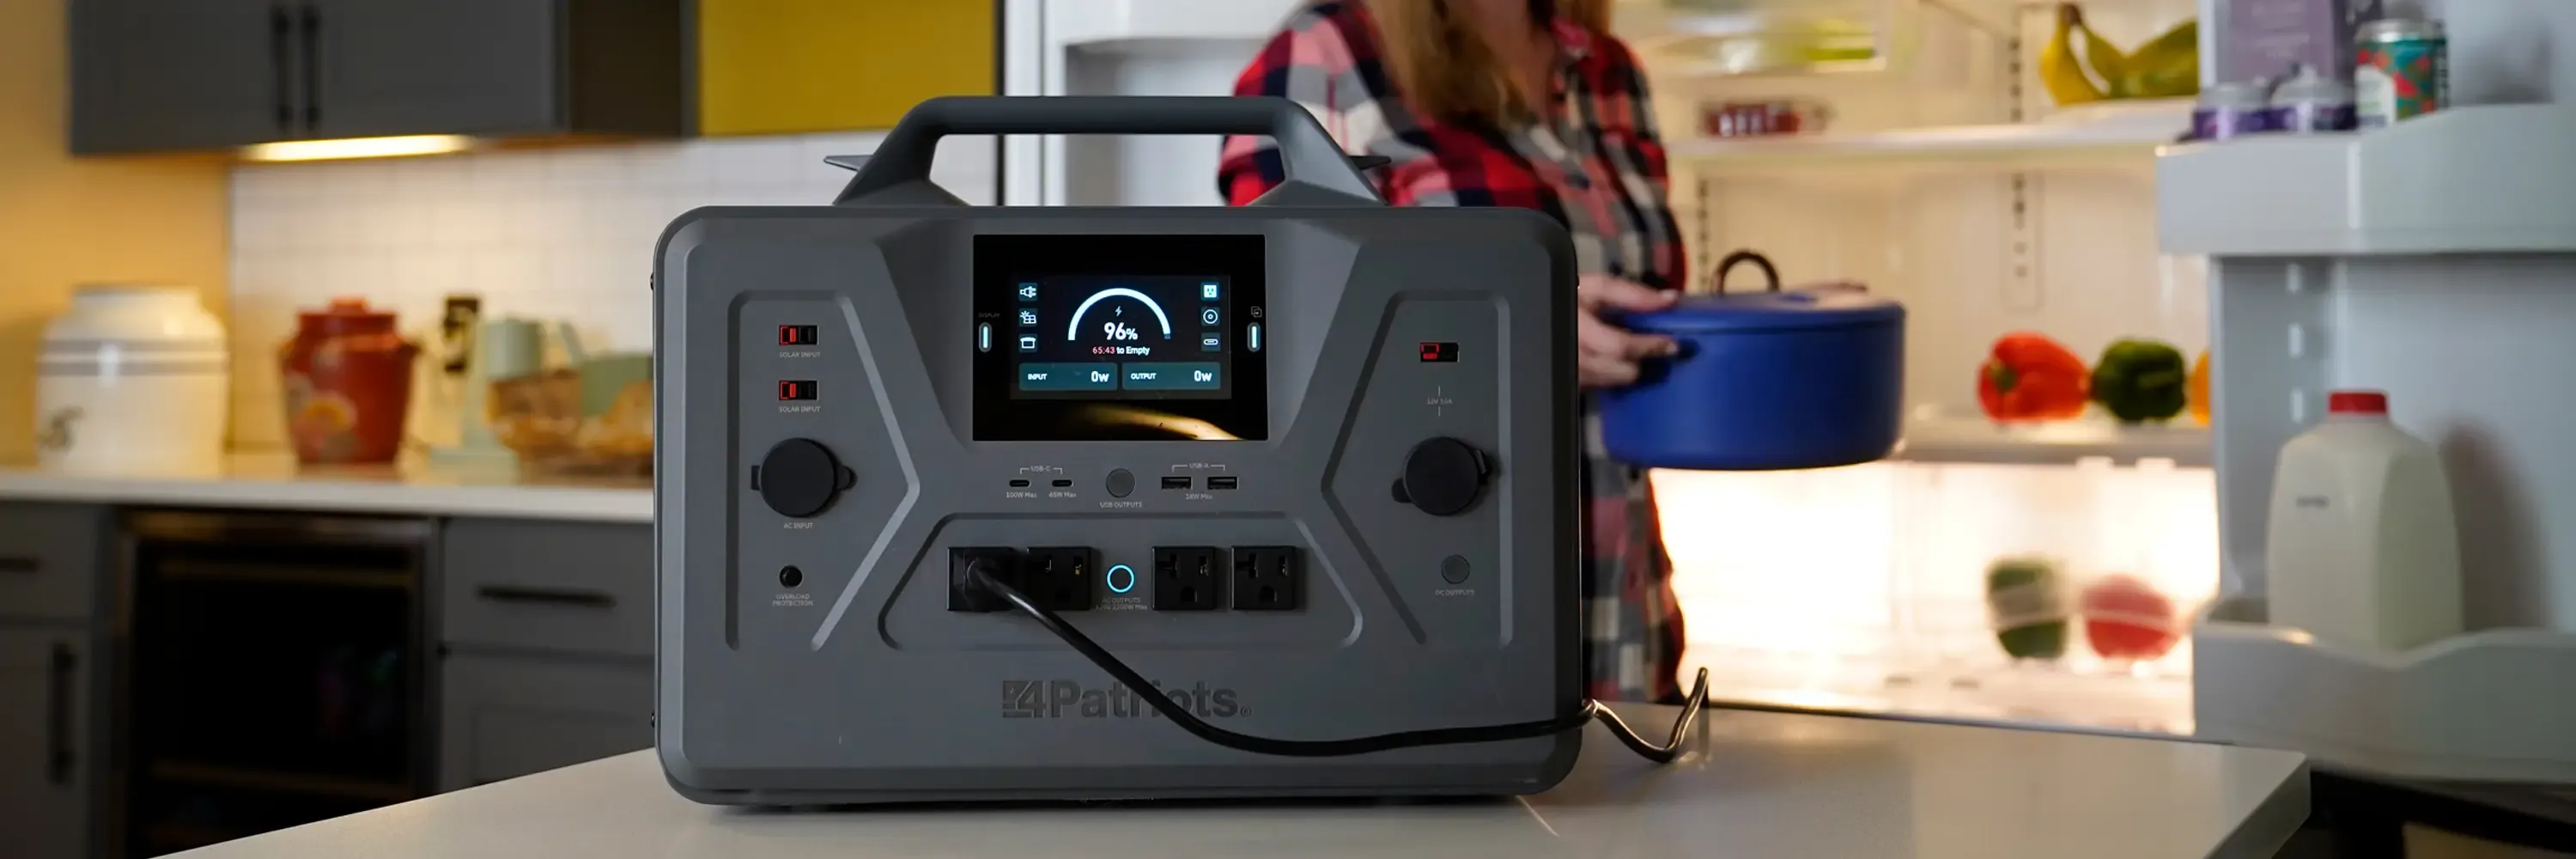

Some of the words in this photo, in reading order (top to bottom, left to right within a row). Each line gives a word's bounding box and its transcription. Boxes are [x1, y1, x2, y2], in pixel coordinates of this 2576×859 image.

[1104, 321, 1139, 340] 96%
[1092, 346, 1115, 355] 65:43
[1115, 346, 1125, 355] to
[1126, 345, 1151, 356] Empty
[1130, 372, 1157, 381] OUTPUT
